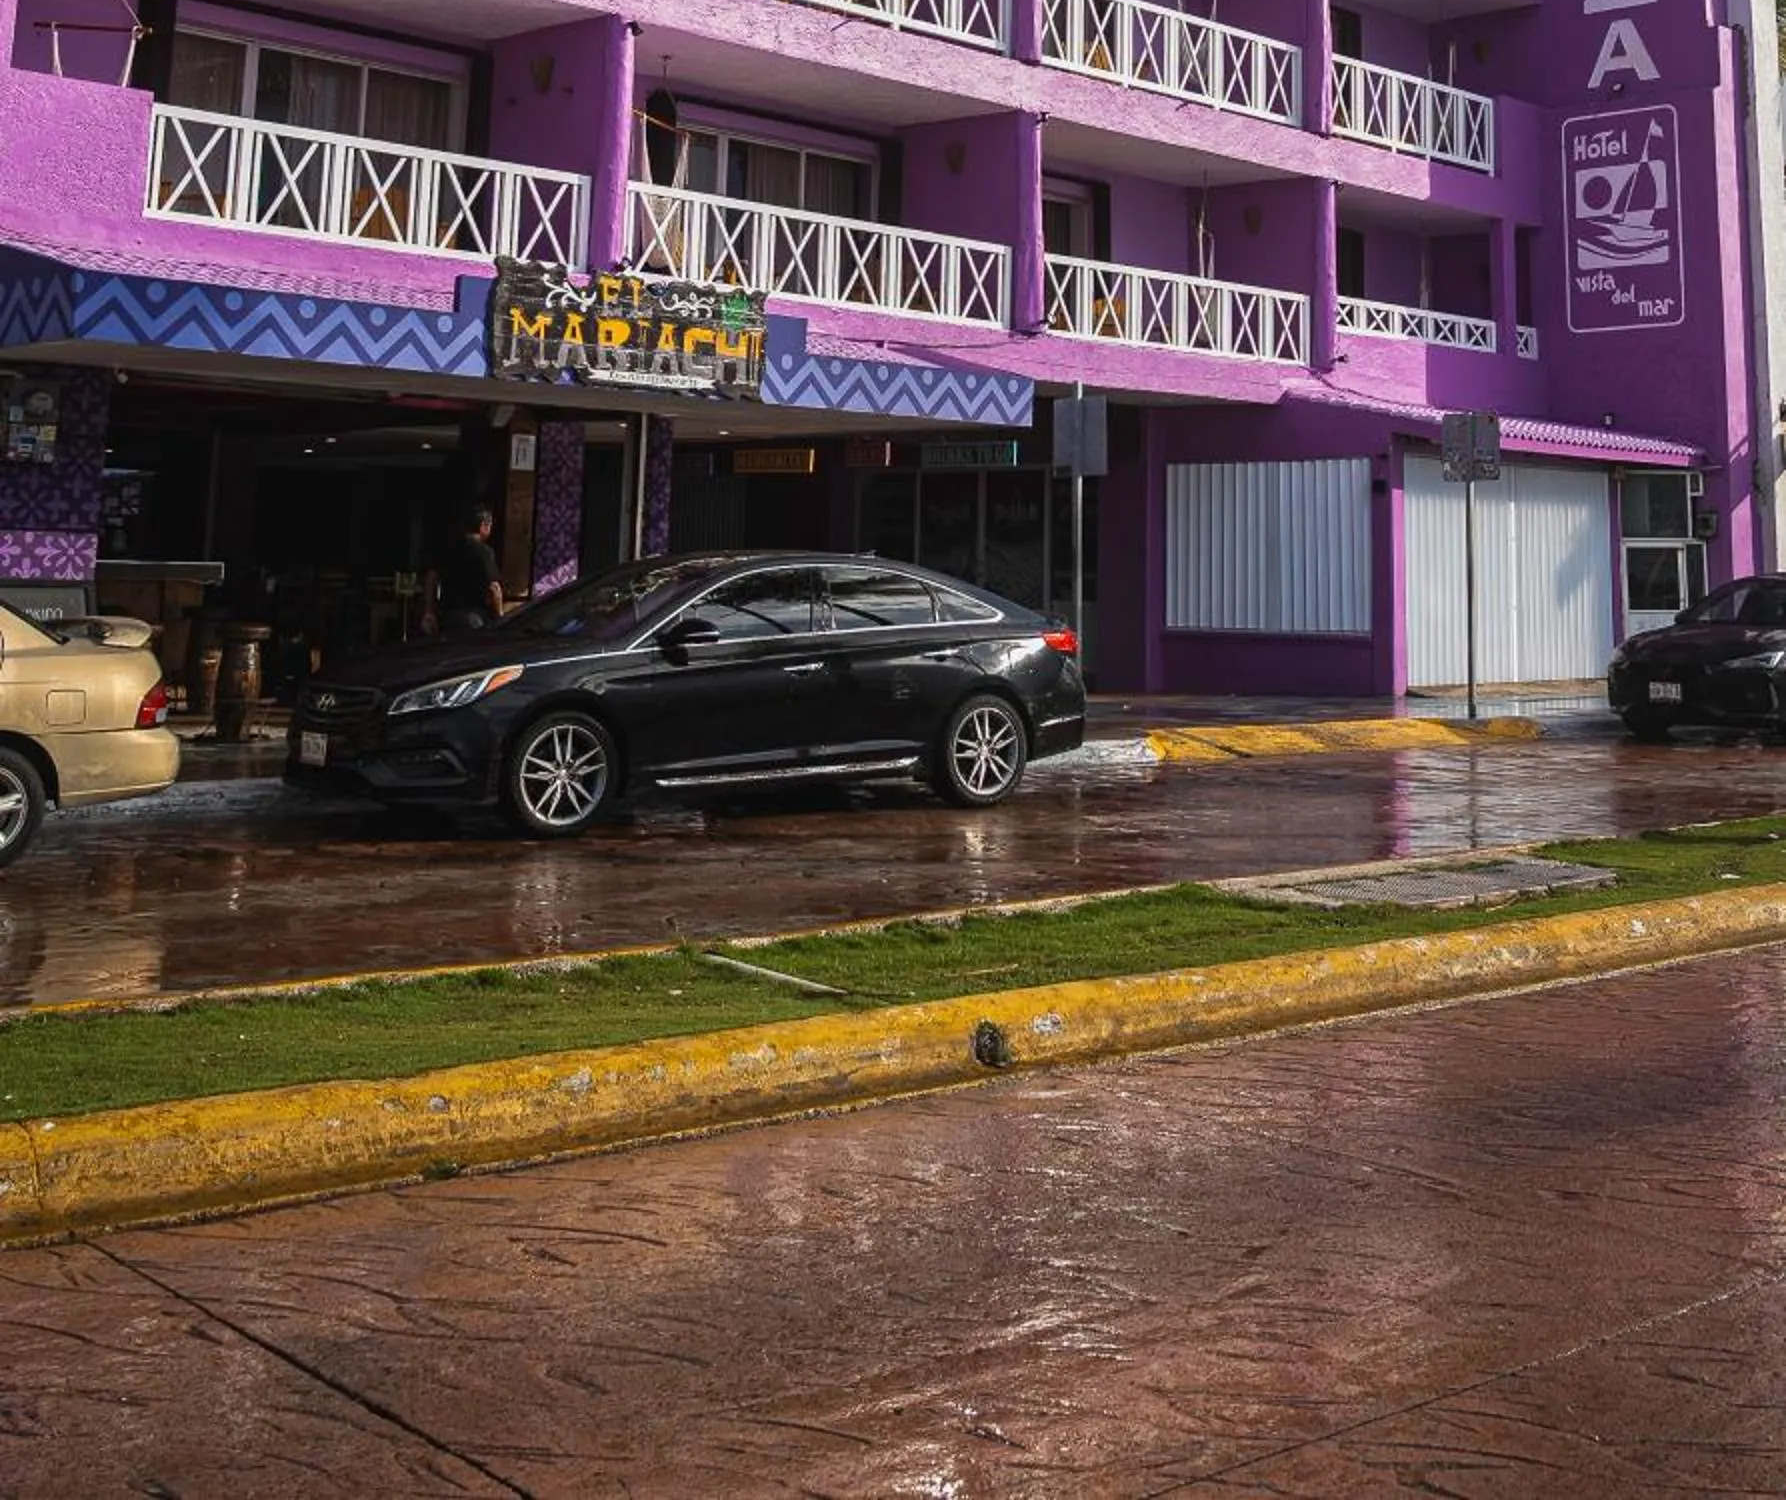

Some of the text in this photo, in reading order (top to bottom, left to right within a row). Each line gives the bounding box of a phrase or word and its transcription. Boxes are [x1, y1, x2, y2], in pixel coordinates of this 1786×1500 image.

[1576, 270, 1616, 293] vista
[1611, 284, 1636, 305] del
[1638, 298, 1674, 317] mar
[502, 307, 765, 386] MARIACHI
